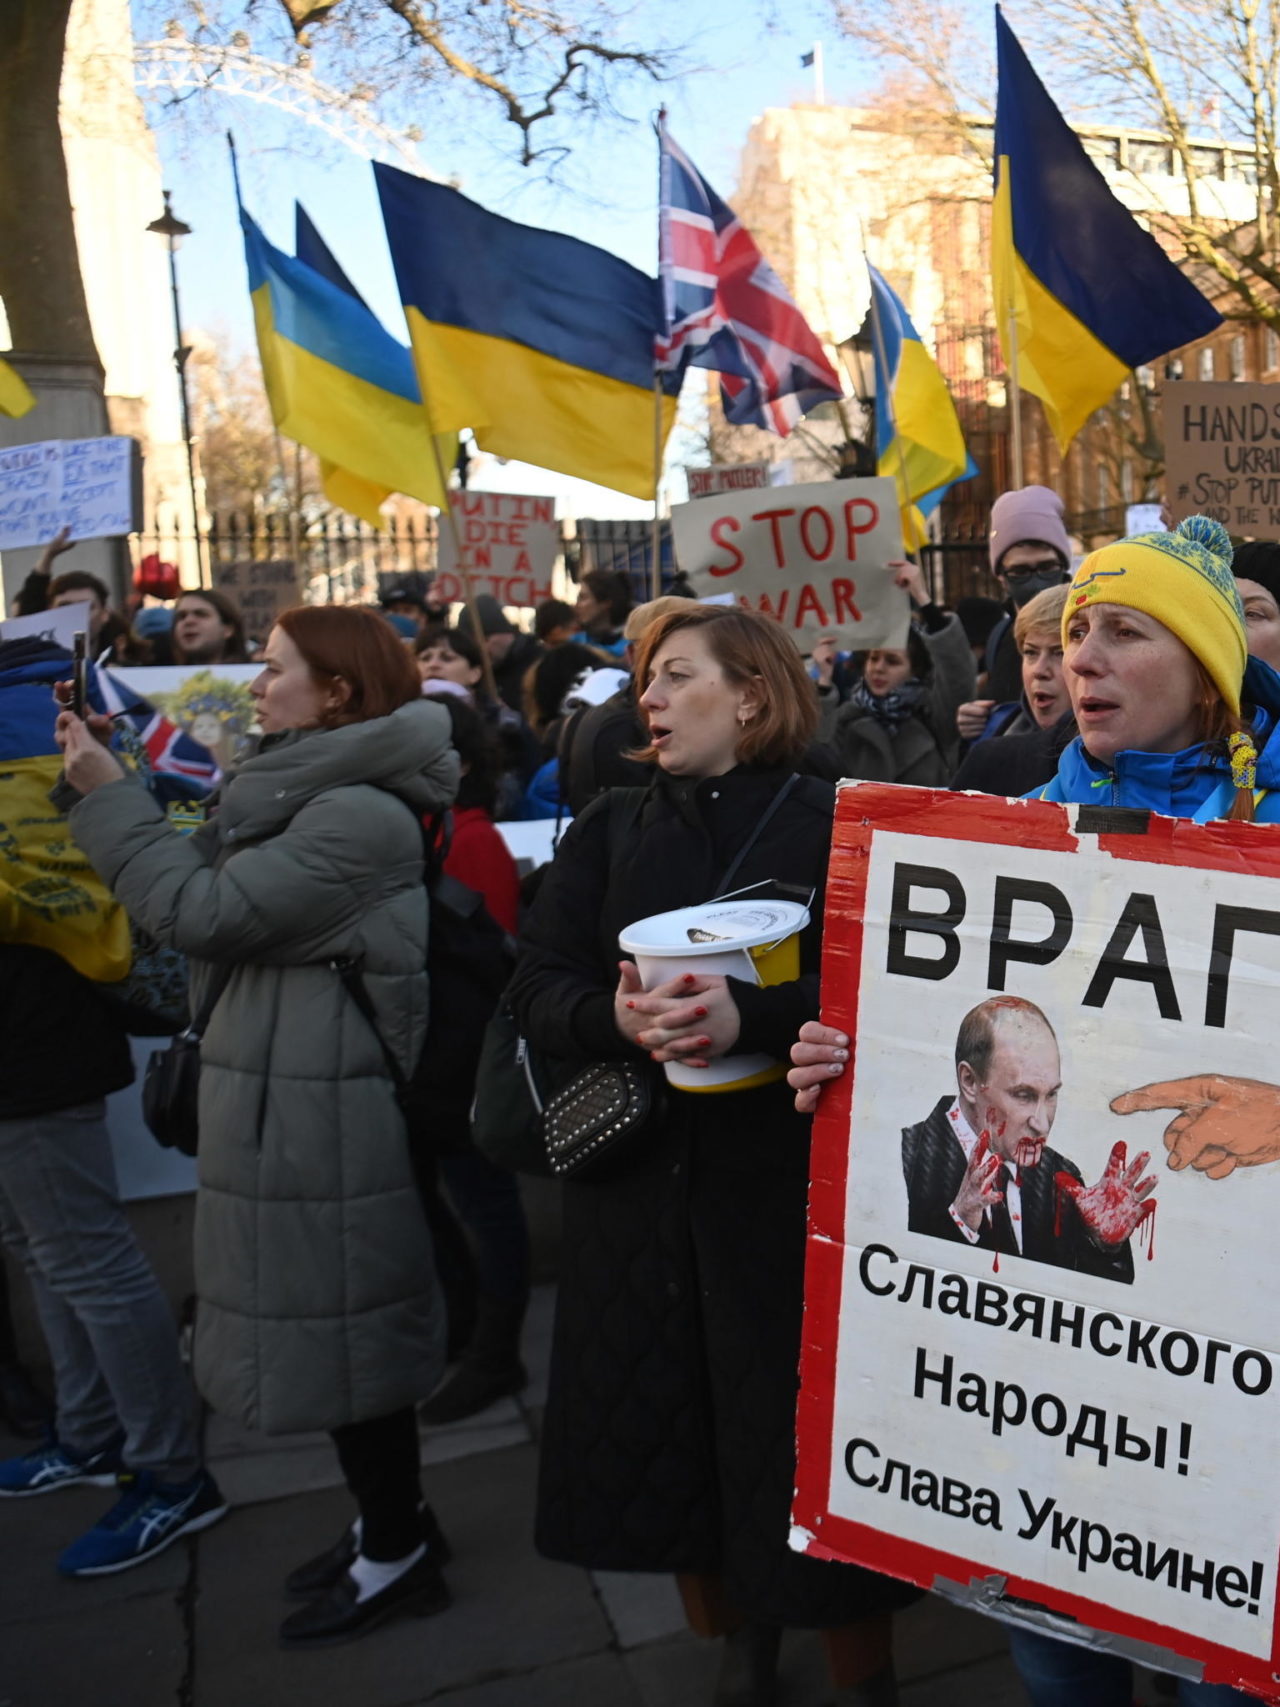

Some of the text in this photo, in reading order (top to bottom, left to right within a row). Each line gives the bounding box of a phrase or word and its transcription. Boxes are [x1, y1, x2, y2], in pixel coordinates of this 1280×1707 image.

[465, 519, 529, 547] DIE
[708, 497, 881, 578] STOP
[1235, 506, 1261, 525] THE
[513, 550, 534, 573] A
[739, 577, 863, 629] WAR
[859, 1243, 1273, 1396] Славянского
[913, 1347, 1193, 1476] Народы!
[843, 1437, 1265, 1616] Слава Украине!
